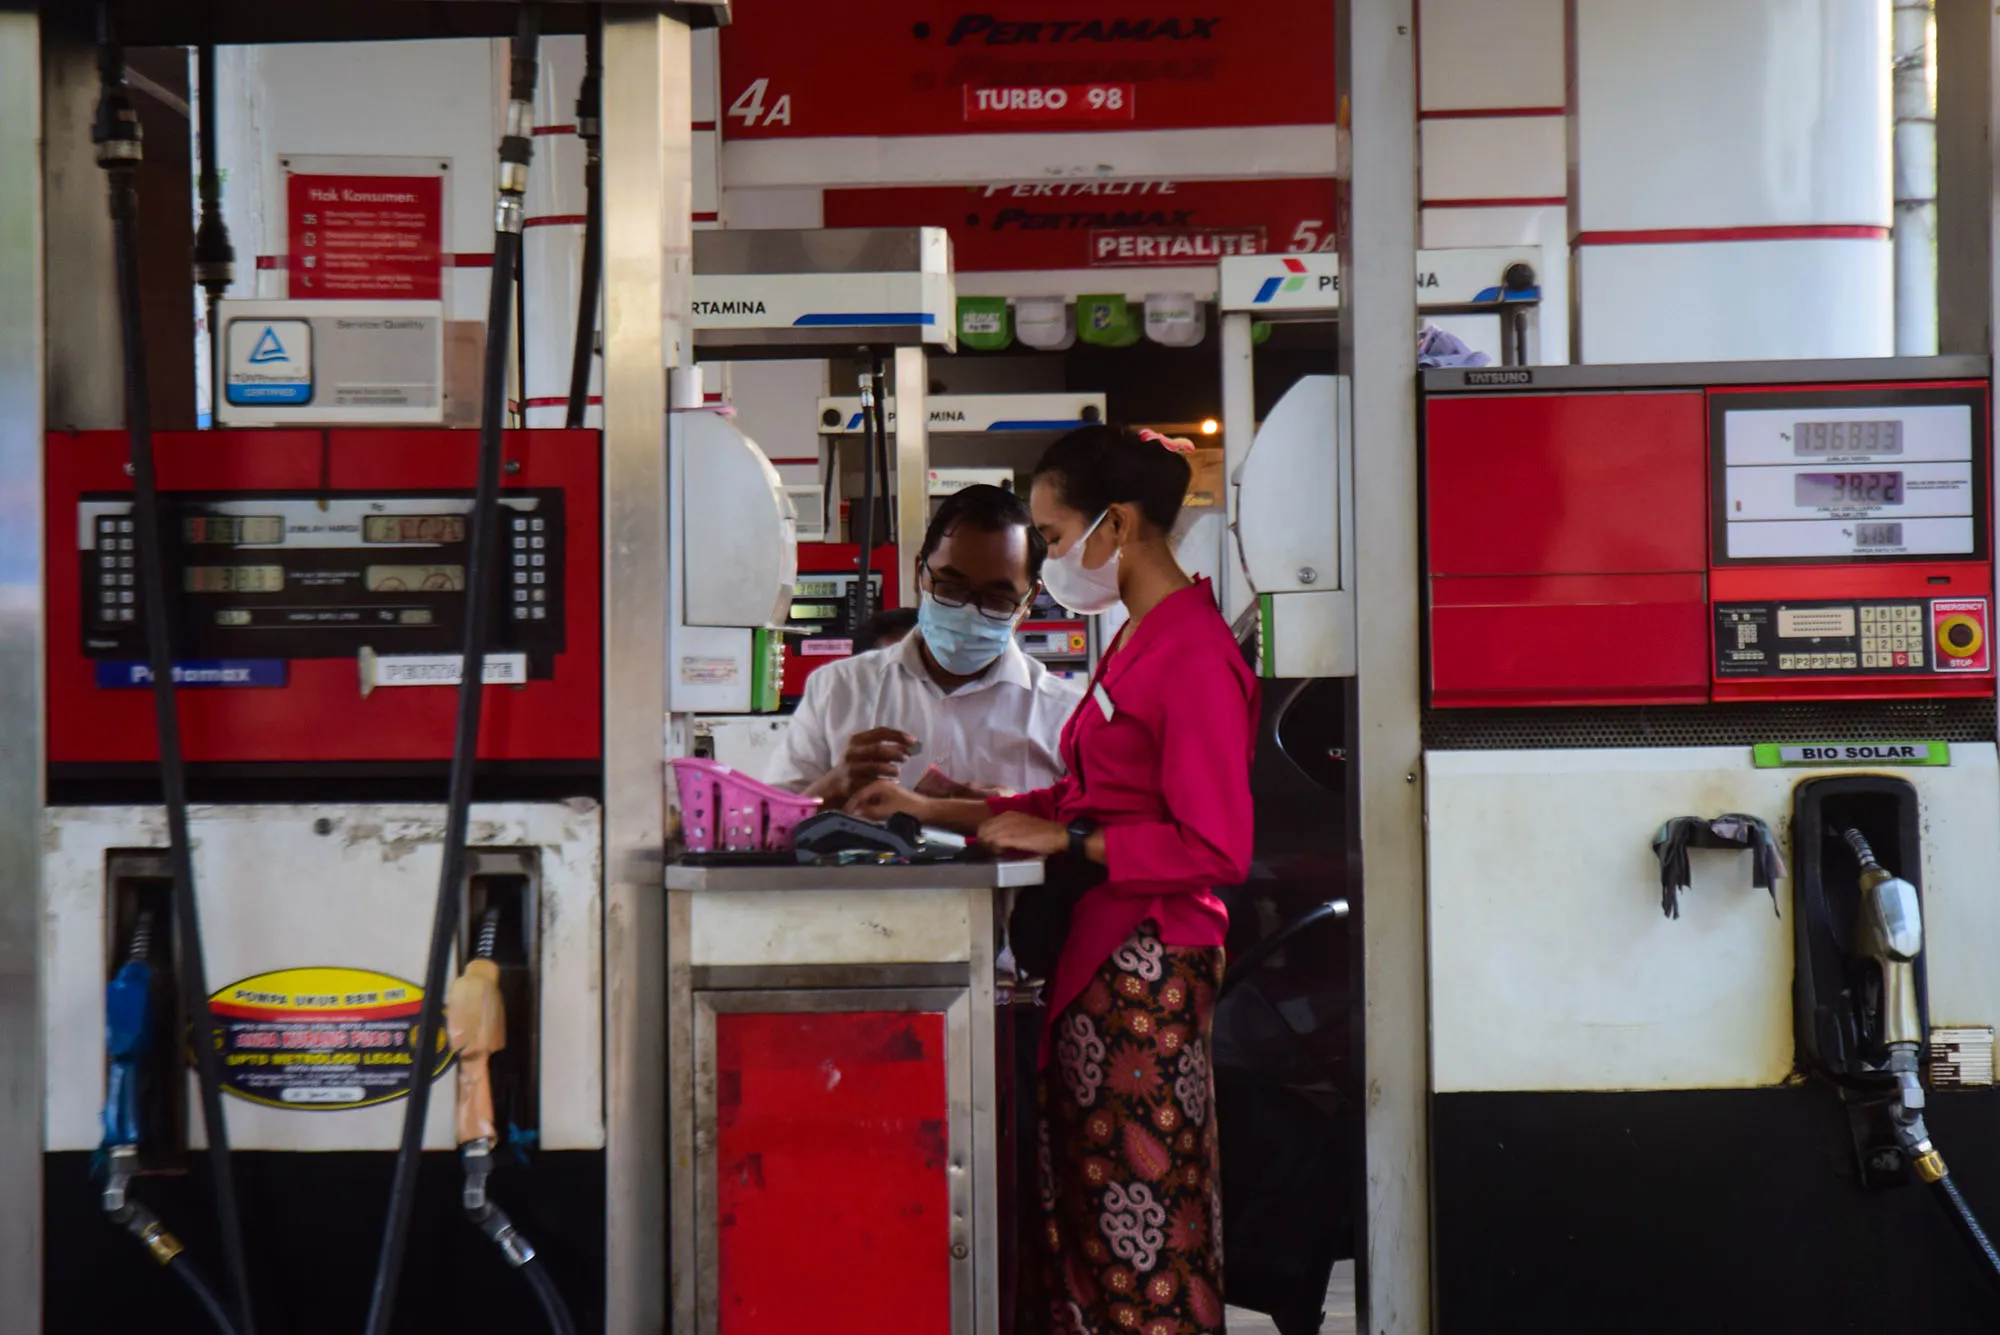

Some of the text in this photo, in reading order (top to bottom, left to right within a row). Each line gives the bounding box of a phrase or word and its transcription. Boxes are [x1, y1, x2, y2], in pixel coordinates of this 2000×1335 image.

[946, 14, 1220, 46] PERTAMAX
[728, 78, 791, 126] 4A
[976, 88, 1123, 110] TURBO 98
[991, 208, 1196, 231] PERTAMAX
[1097, 233, 1257, 257] PERTALITE
[692, 301, 766, 315] RTAMINA
[1468, 372, 1529, 383] TATSUNO
[888, 411, 965, 422] PMINA
[386, 662, 513, 680] PERTATE
[1950, 659, 1973, 667] STOP
[131, 666, 251, 682] Ptamax
[1802, 746, 1916, 759] BIO SOLAR
